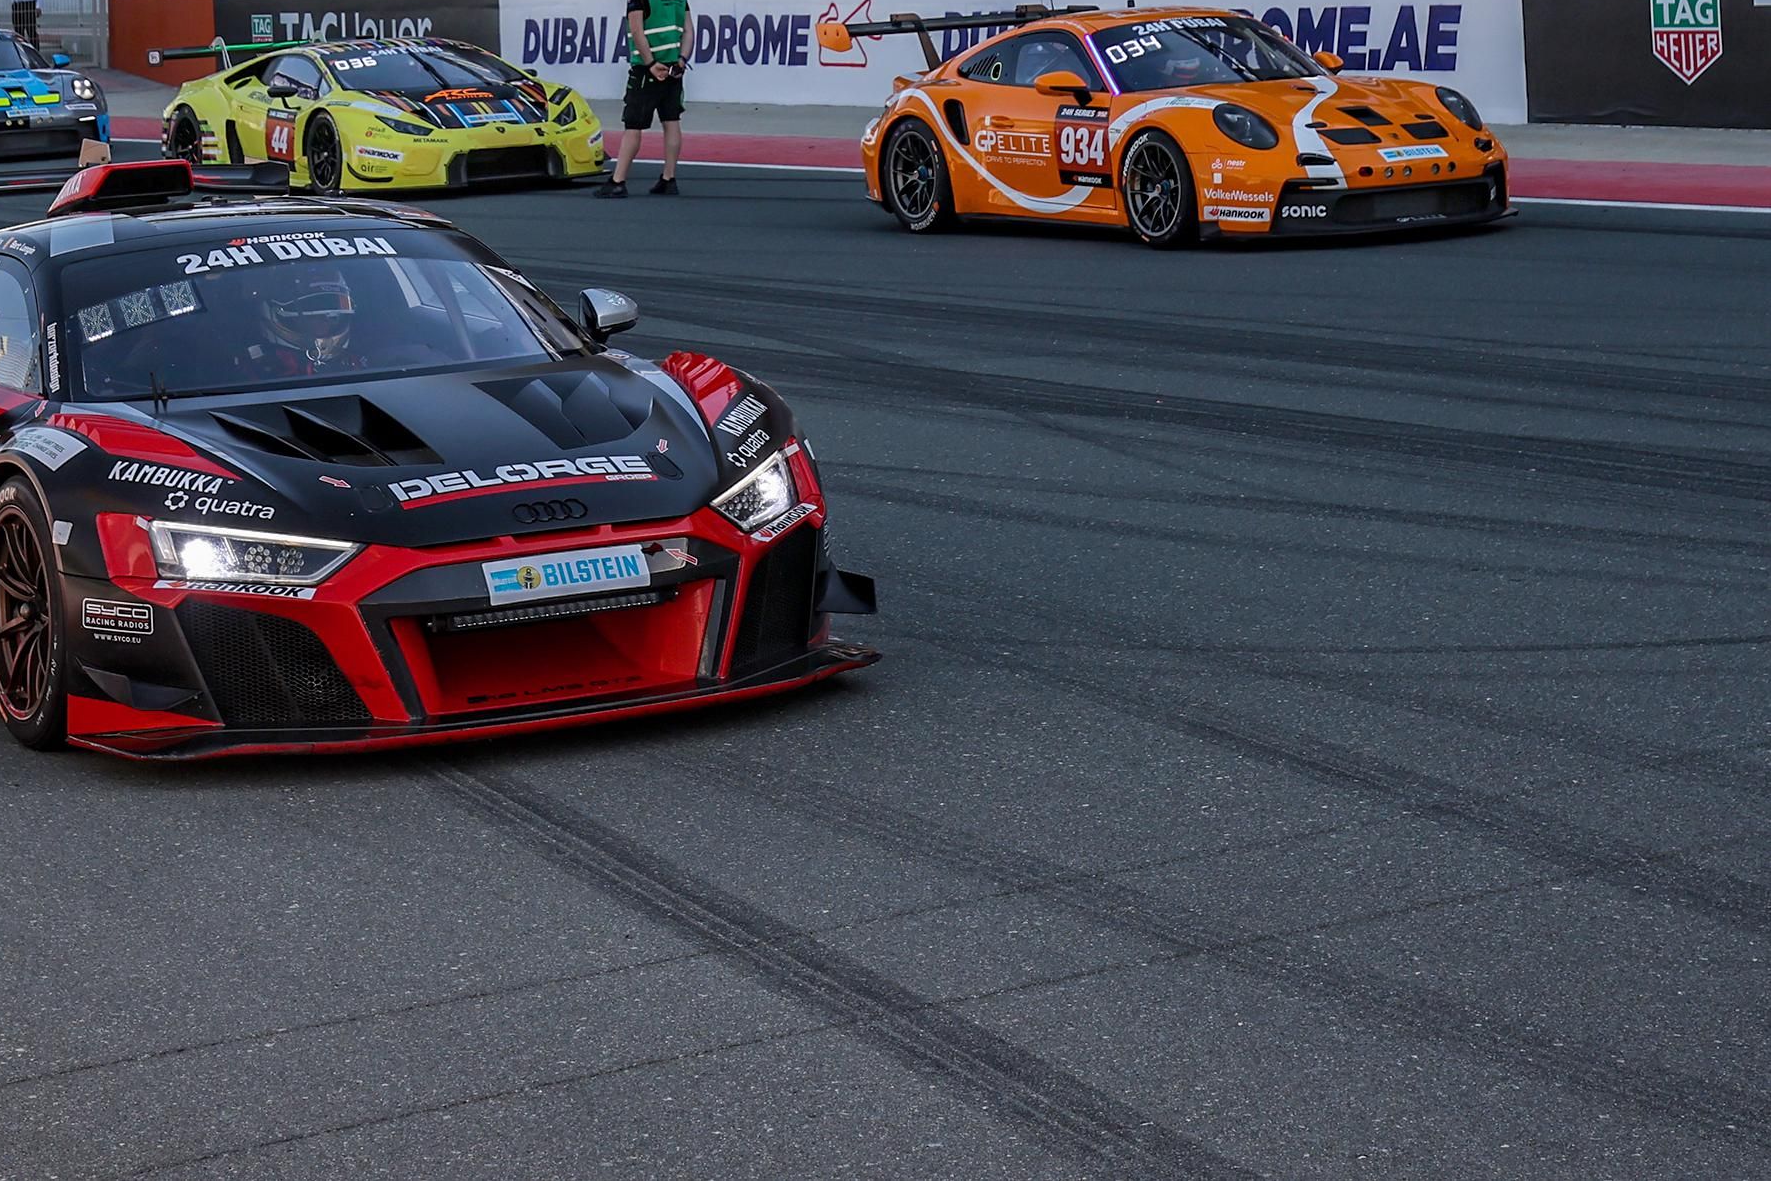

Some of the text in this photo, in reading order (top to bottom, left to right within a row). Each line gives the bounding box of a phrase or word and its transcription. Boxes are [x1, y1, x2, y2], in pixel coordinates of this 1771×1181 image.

[253, 19, 272, 35] TAG
[522, 14, 812, 67] DUBAI ADROME
[1131, 20, 1171, 36] 24H
[334, 56, 378, 71] 036
[1104, 34, 1162, 65] 034
[1656, 33, 1718, 77] HEUER
[271, 125, 288, 154] 44
[997, 134, 1051, 153] ELITE
[1060, 126, 1105, 166] 934
[1203, 187, 1275, 202] VolkerWessels
[176, 237, 398, 275] 24H DUBAI
[738, 428, 771, 460] quatra
[108, 461, 223, 494] KAMBUKKA
[387, 455, 653, 502] DELORGE
[194, 497, 276, 520] quatra
[541, 554, 641, 588] BILSTEIN
[85, 616, 150, 631] RACING RADIOS
[86, 603, 150, 619] SYCO
